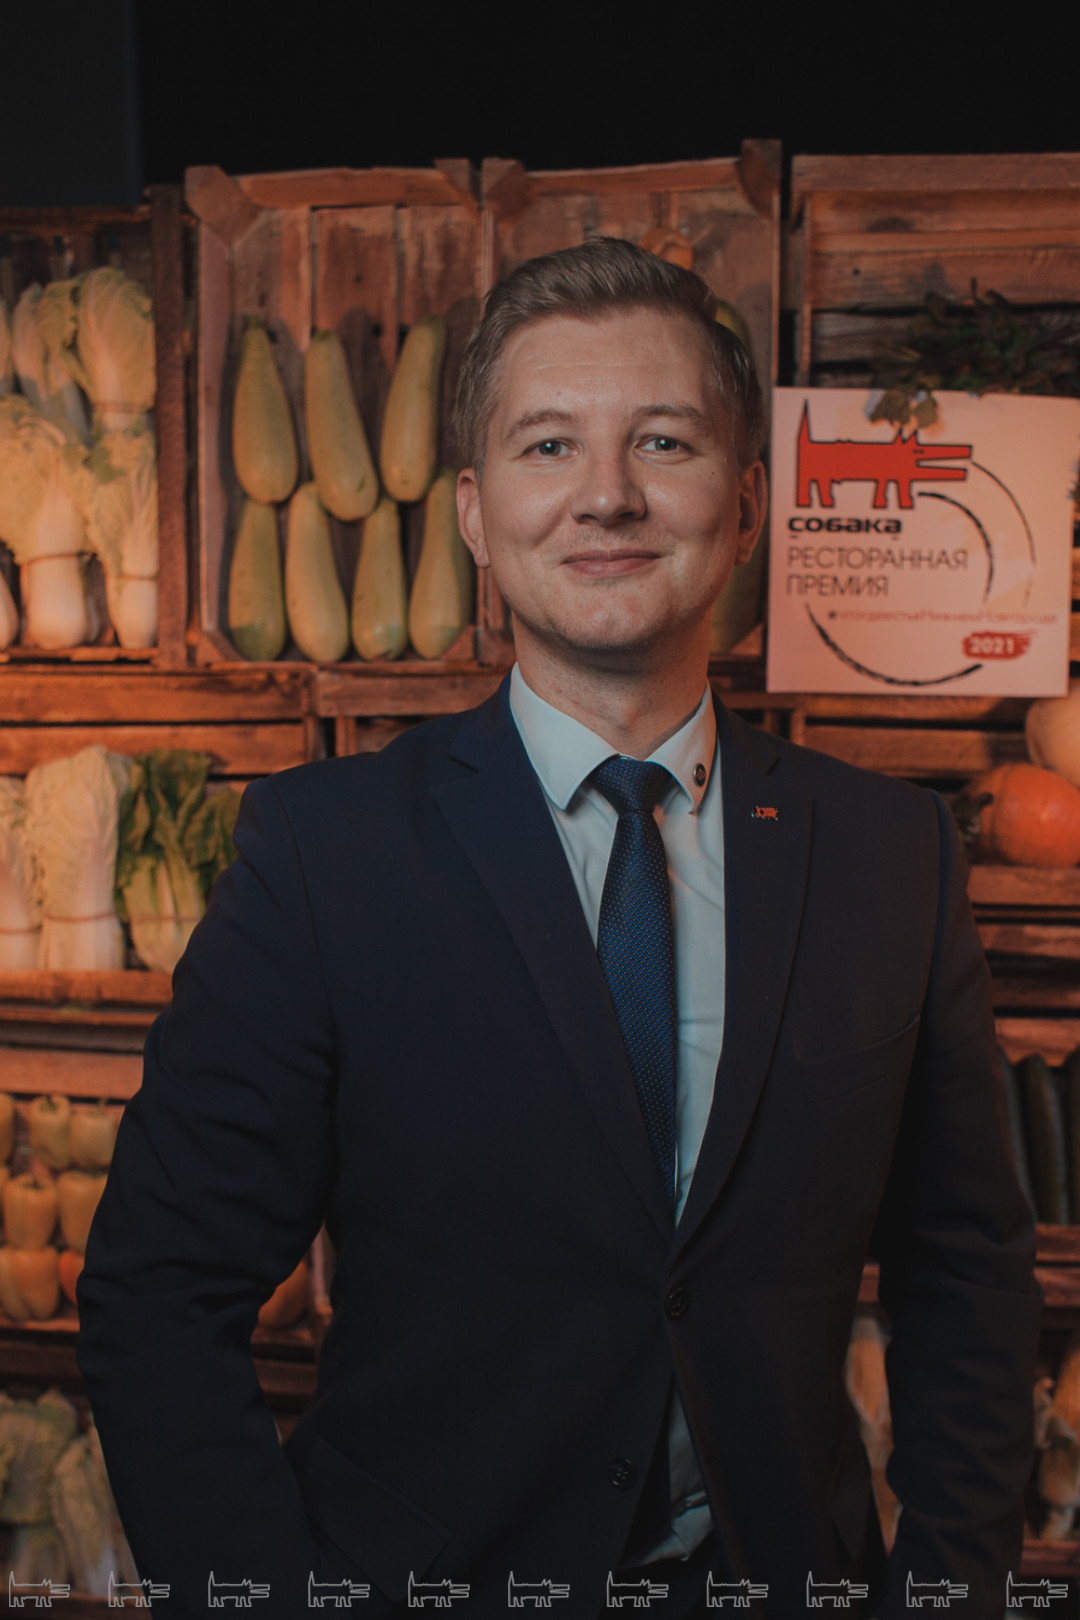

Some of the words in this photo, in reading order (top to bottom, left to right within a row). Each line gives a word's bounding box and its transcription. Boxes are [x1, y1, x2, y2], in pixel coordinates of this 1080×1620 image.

[787, 546, 969, 570] РЕСТОРАННАЯ
[786, 574, 889, 597] ПРЕМИЯ
[969, 636, 1014, 655] 2021
